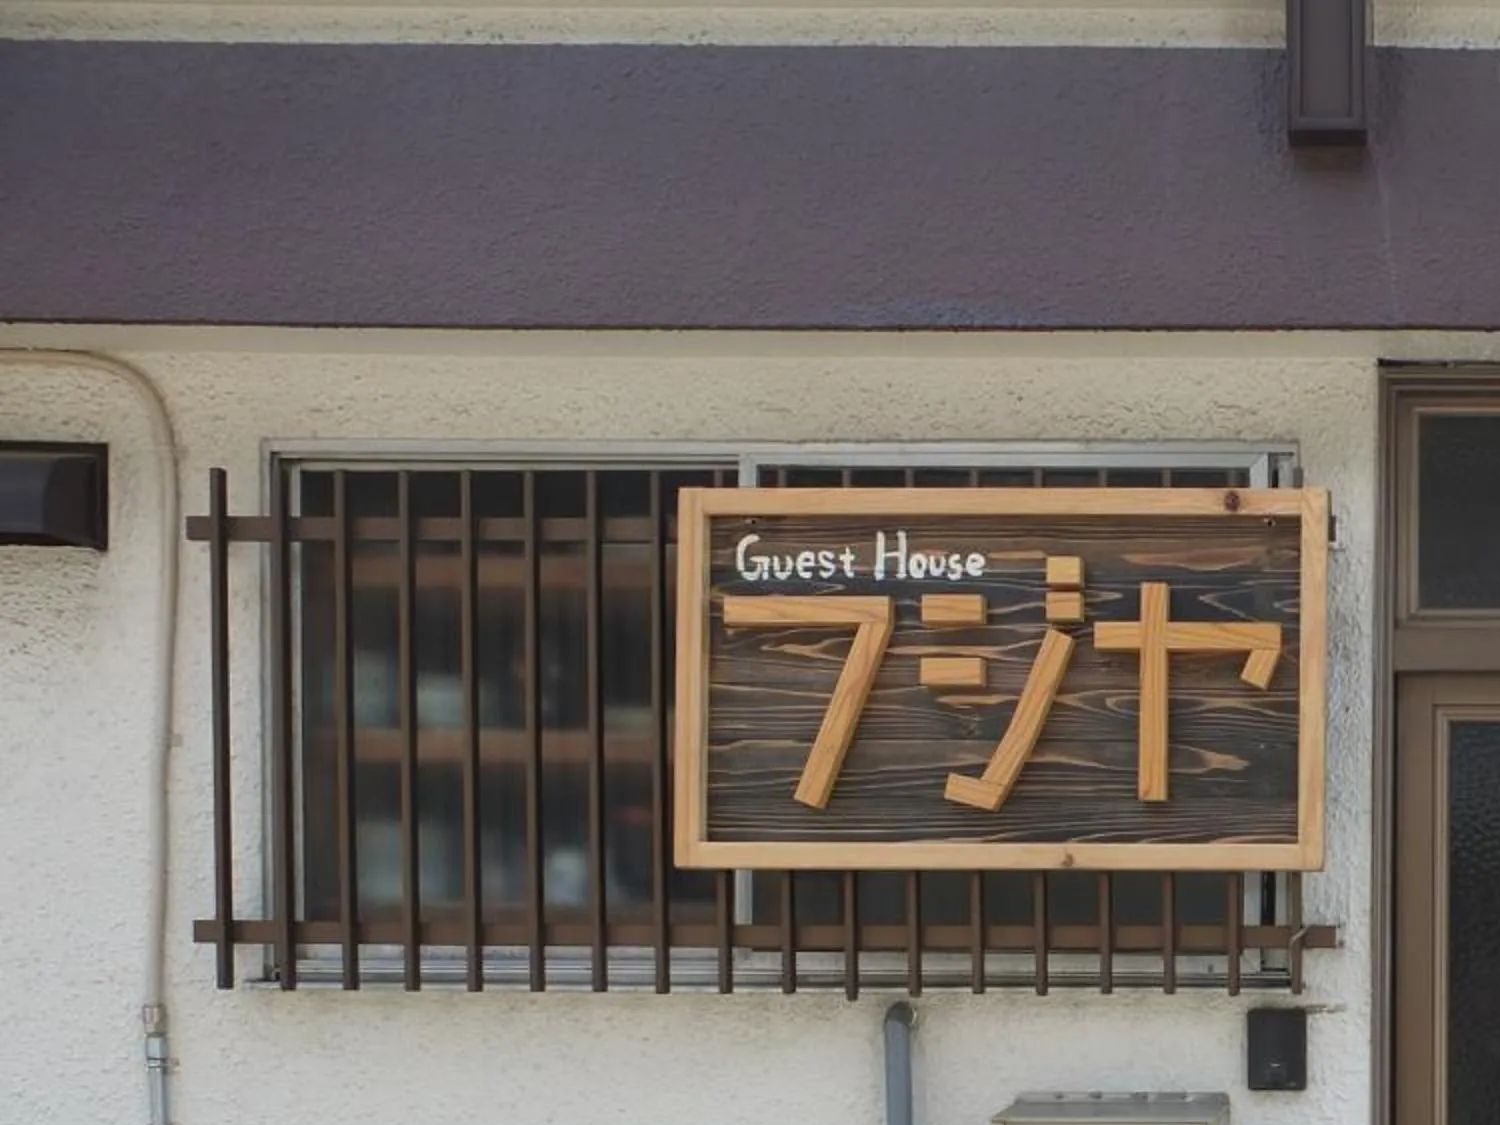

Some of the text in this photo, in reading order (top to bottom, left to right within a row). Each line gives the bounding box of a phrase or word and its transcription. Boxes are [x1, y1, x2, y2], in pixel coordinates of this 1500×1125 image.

[735, 530, 988, 582] Guest House
[722, 556, 1282, 812] フジヤ
